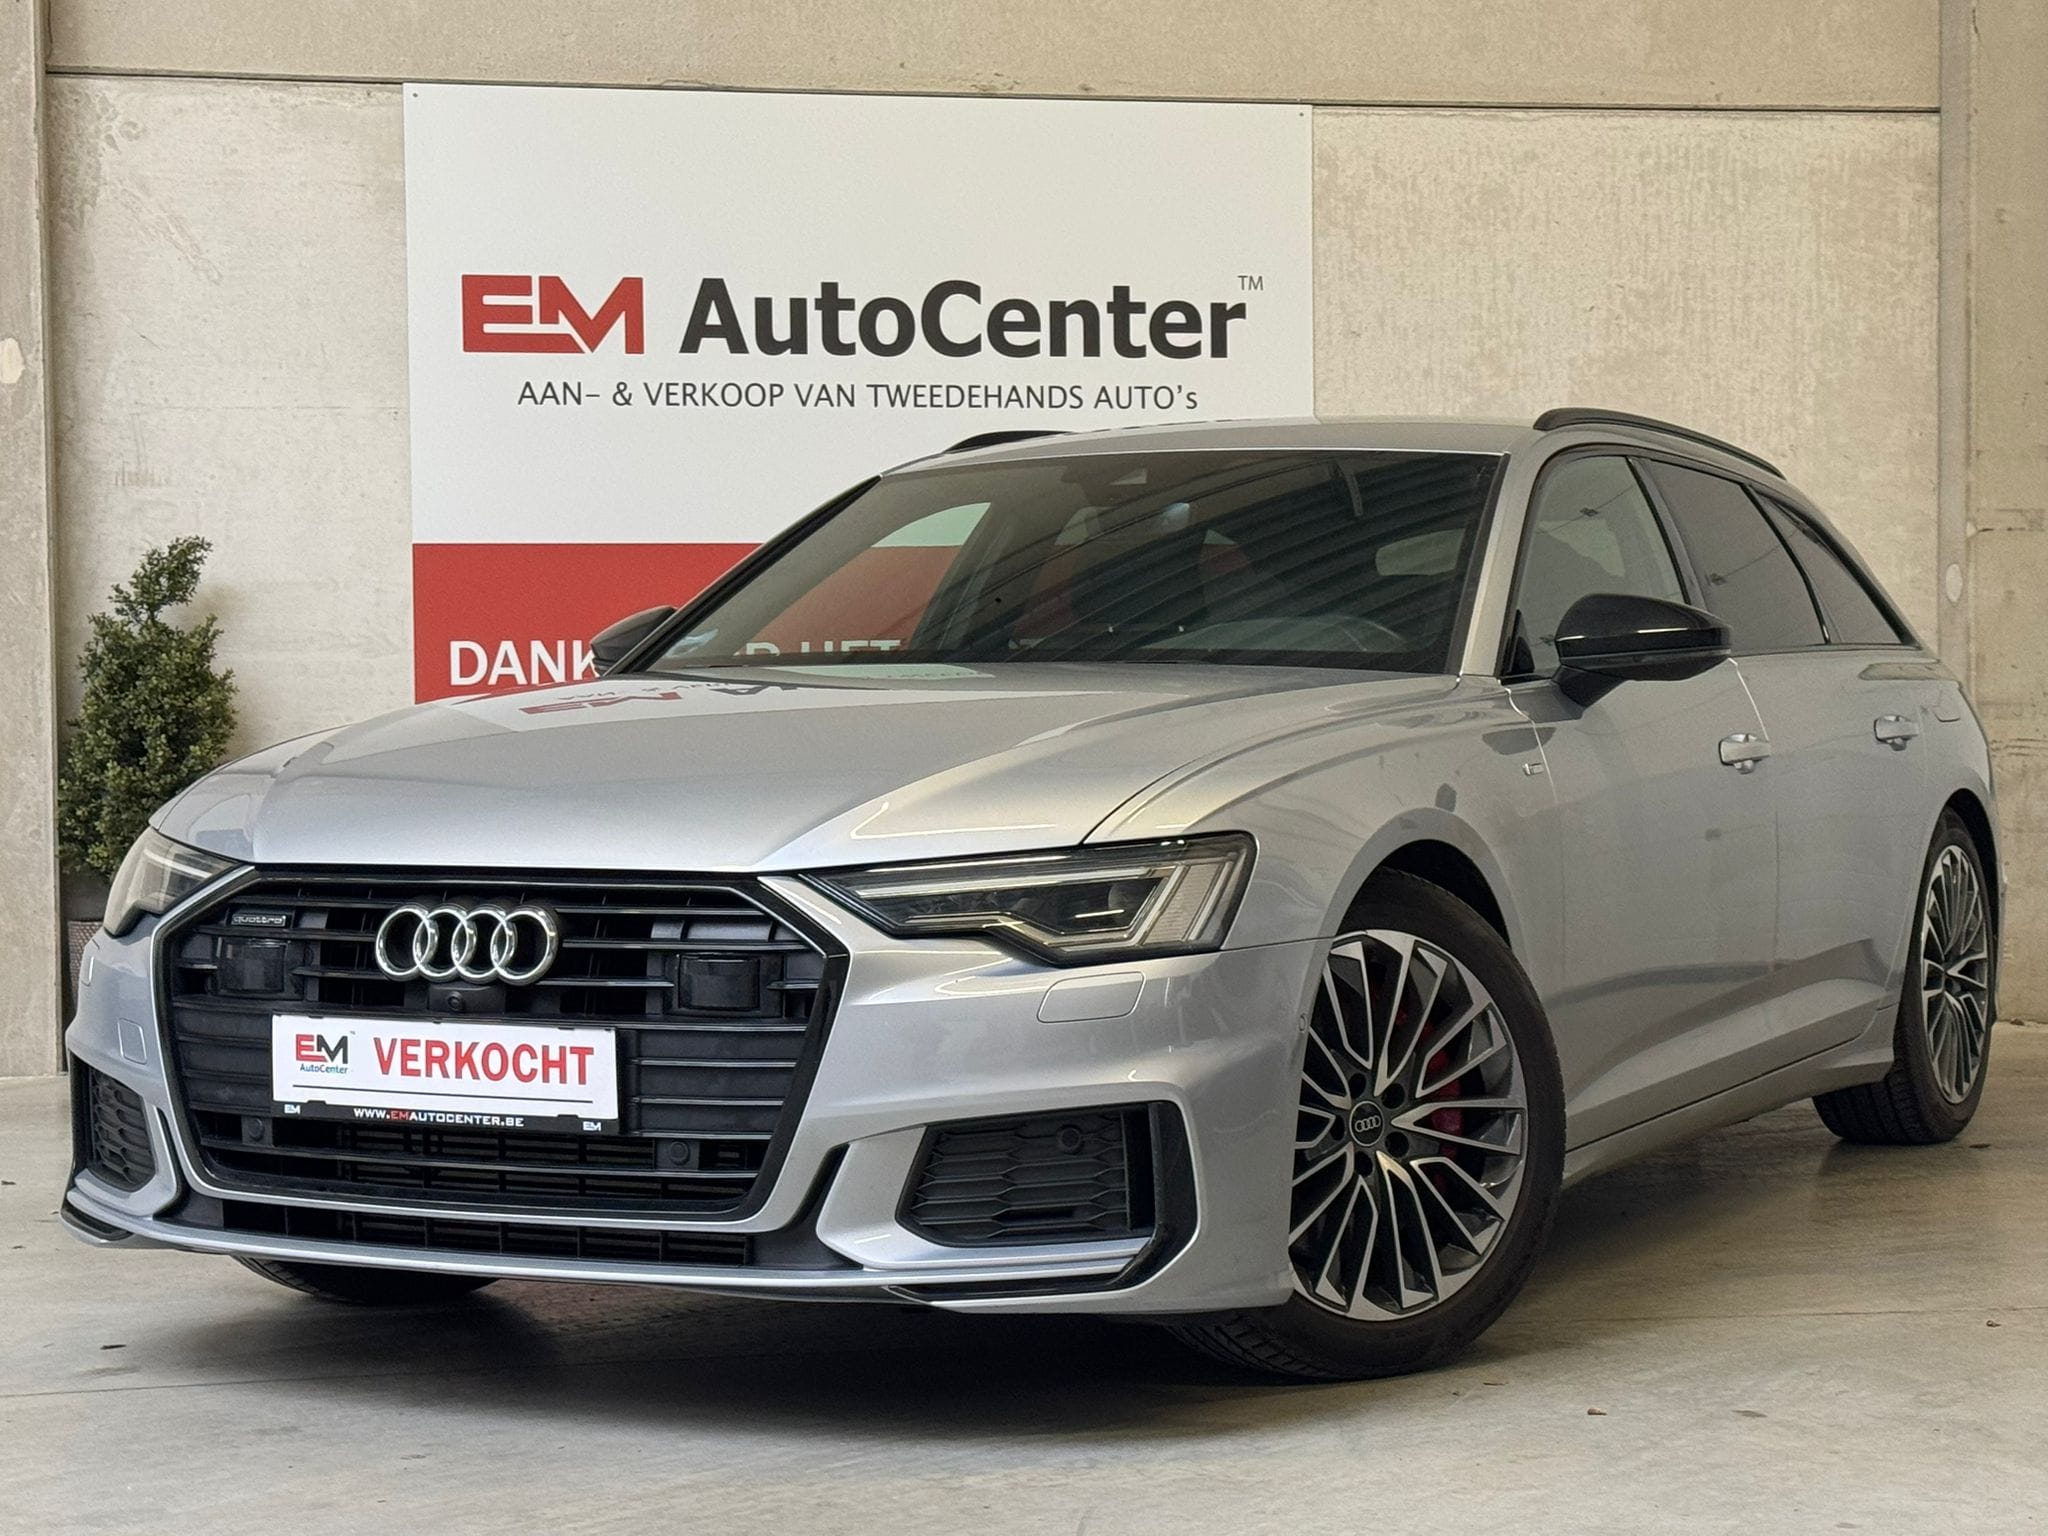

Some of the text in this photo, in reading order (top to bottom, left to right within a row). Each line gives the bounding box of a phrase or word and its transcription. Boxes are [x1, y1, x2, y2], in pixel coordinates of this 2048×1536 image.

[462, 274, 1264, 359] EM AutoCenter TM
[517, 380, 1199, 410] AAN- & VERKOOP VAN TWEEDEHANDS AUTO's
[233, 914, 283, 925] quattro
[295, 1033, 349, 1065] EM
[373, 1037, 595, 1086] VERKOCHT
[299, 1063, 349, 1074] AutoCenter
[353, 1107, 525, 1128] WWW.EMAUTOCENTER.BE
